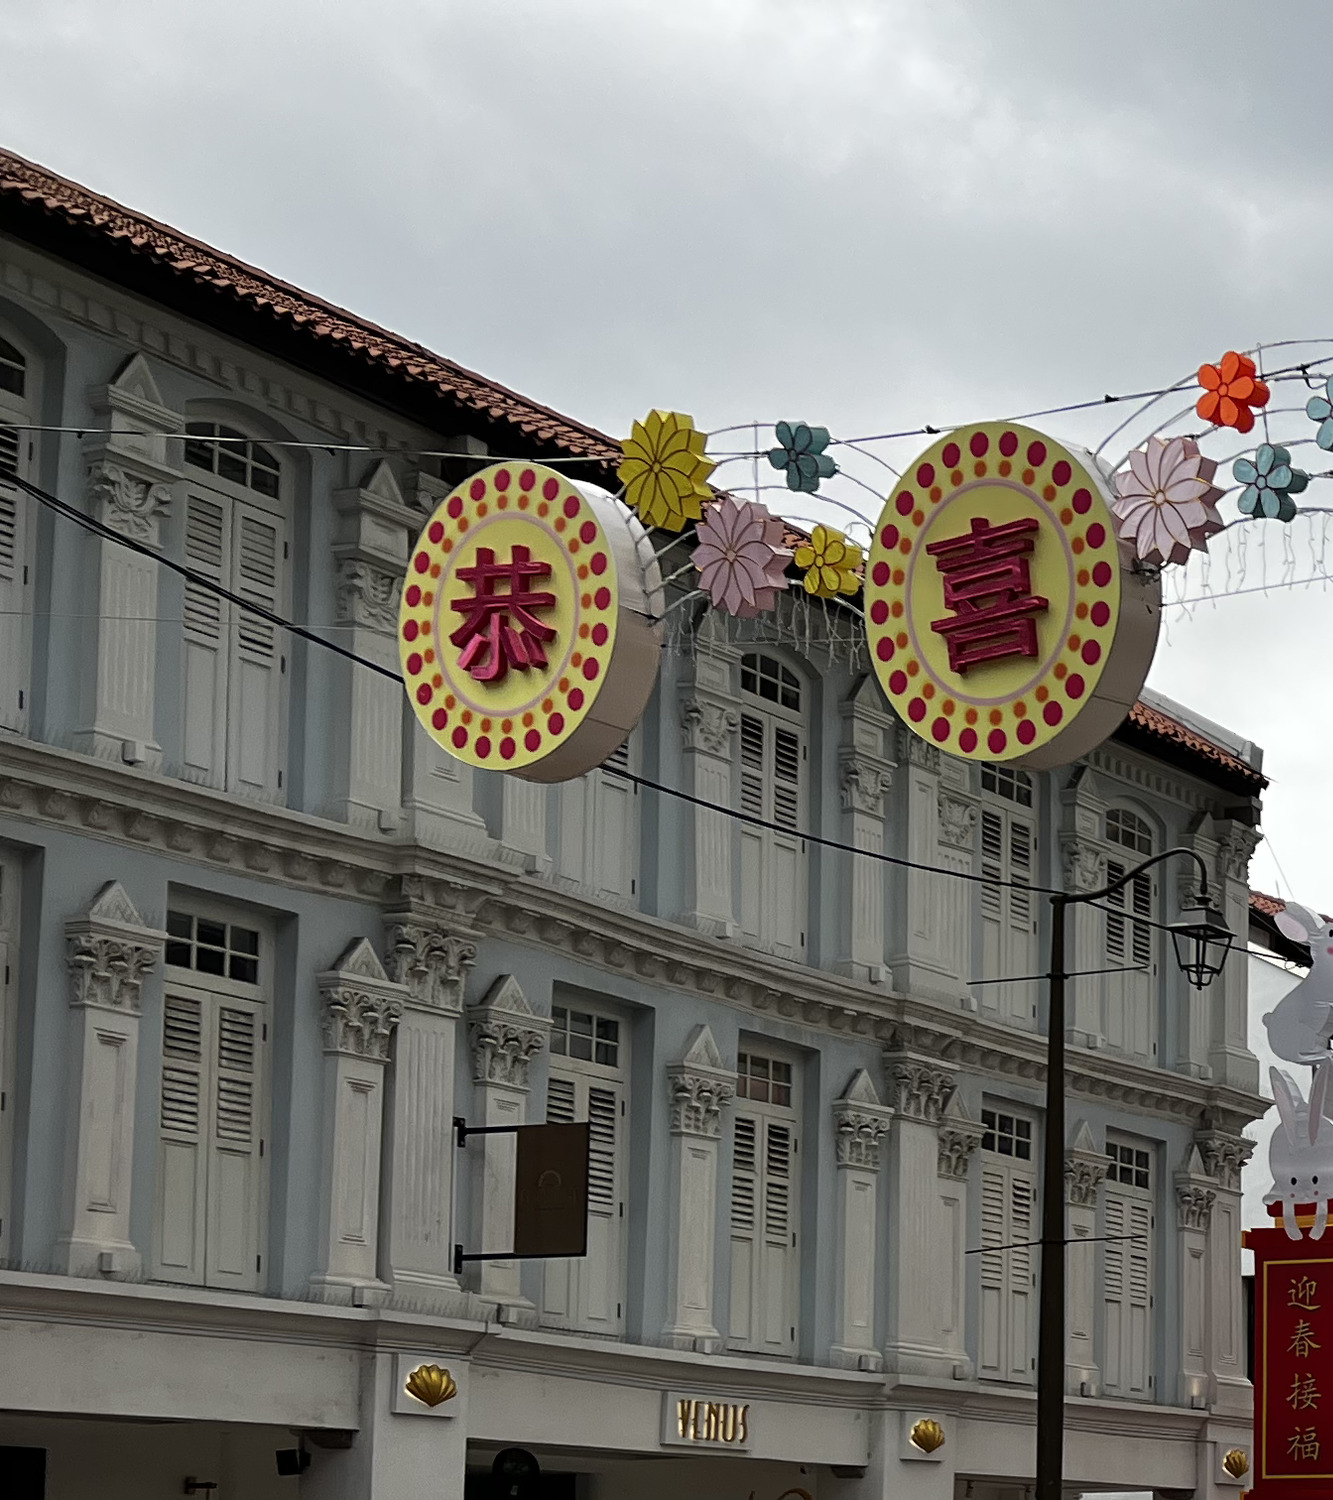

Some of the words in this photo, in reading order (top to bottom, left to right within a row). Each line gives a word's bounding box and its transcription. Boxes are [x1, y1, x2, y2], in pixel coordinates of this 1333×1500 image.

[451, 546, 557, 682] 恭
[927, 517, 1048, 674] 喜
[677, 1399, 750, 1444] VENUS
[1286, 1275, 1321, 1461] 迎春接福
